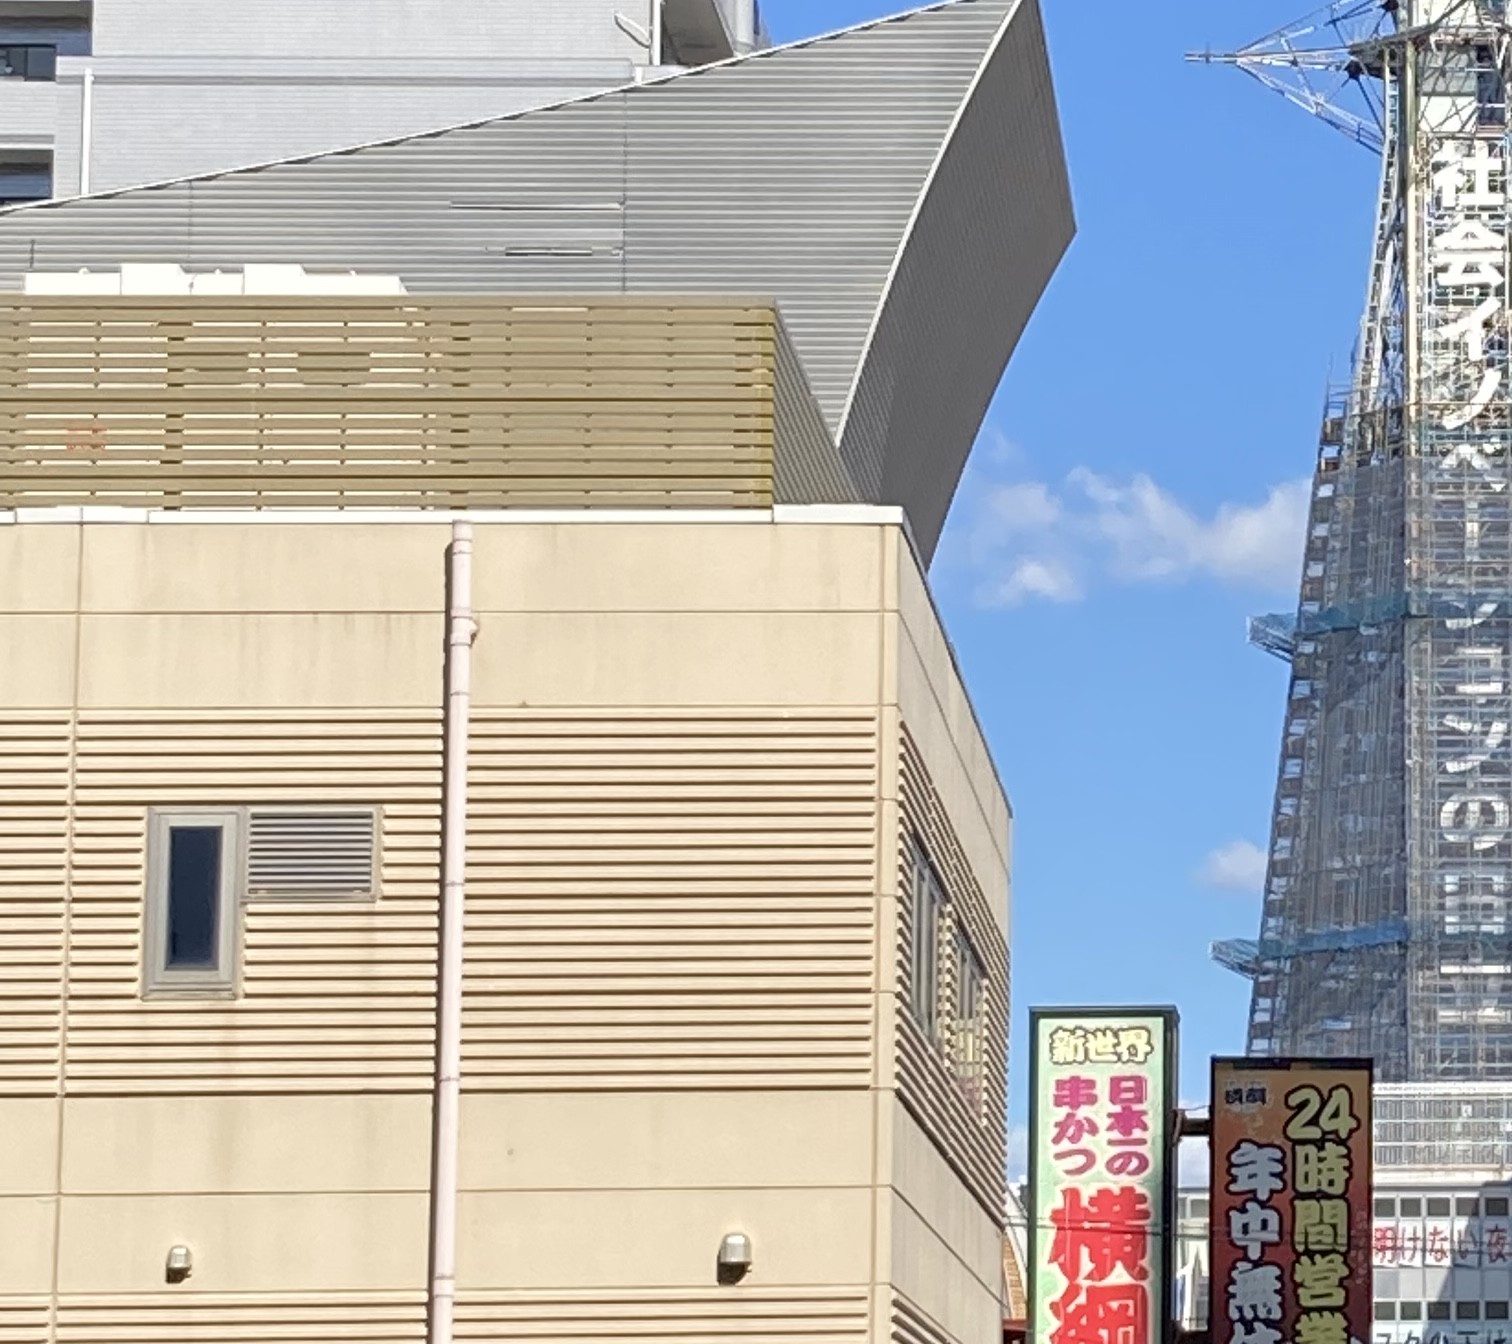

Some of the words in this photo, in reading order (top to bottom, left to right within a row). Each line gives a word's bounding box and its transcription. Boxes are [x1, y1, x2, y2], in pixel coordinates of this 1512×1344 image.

[1050, 1025, 1154, 1065] 新世界
[1051, 1075, 1100, 1177] 串かつ
[1104, 1075, 1150, 1177] 日本一の
